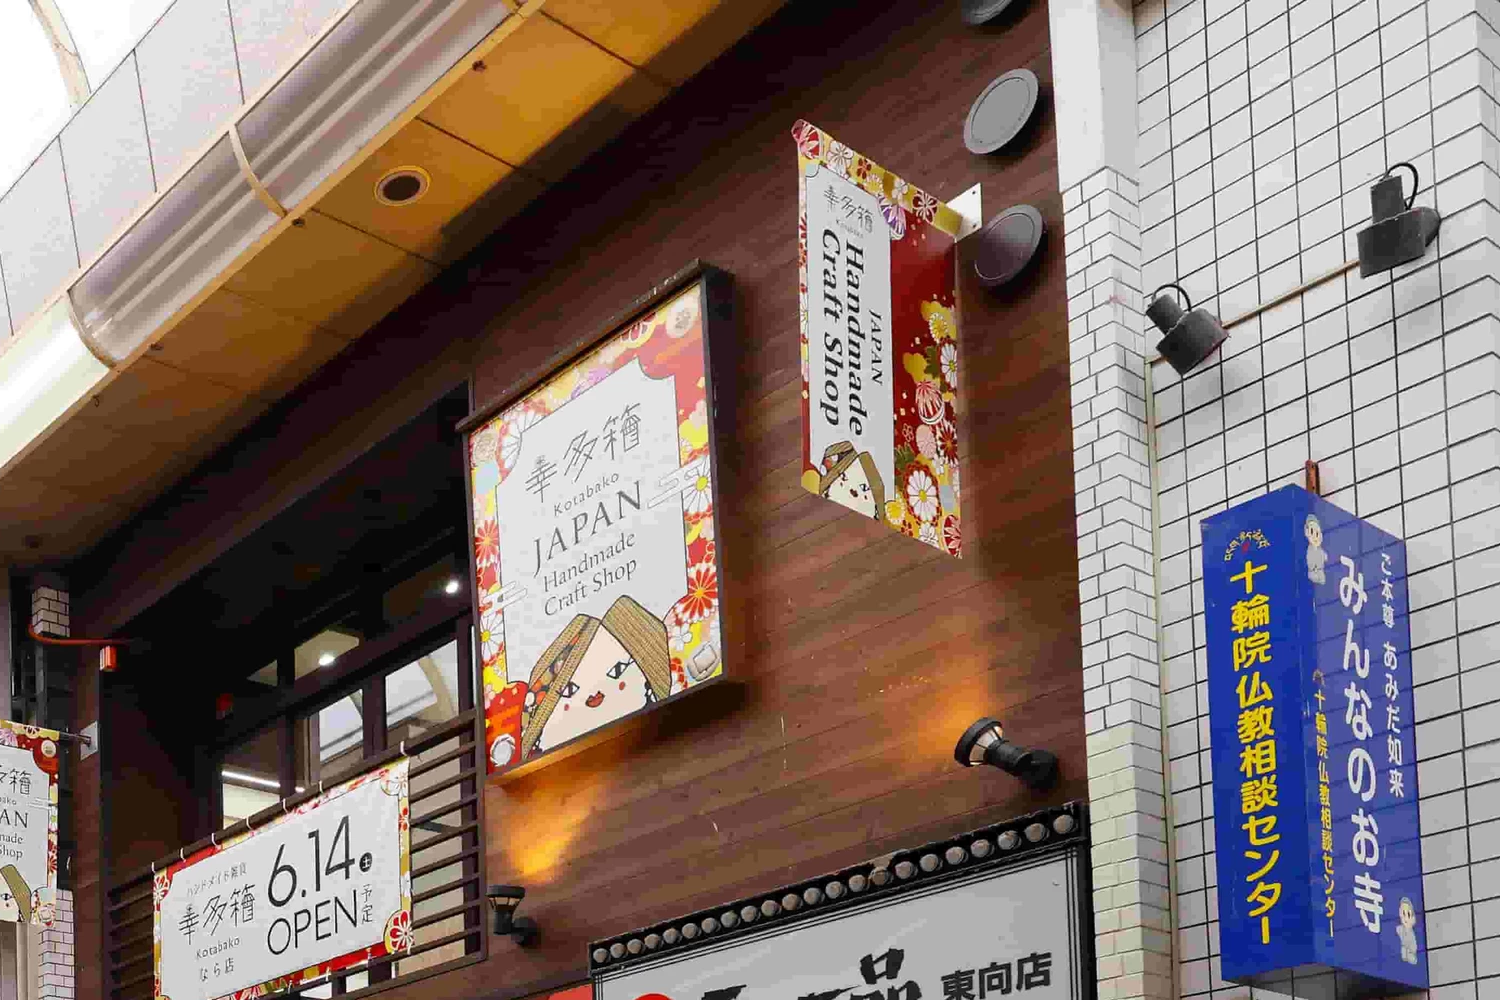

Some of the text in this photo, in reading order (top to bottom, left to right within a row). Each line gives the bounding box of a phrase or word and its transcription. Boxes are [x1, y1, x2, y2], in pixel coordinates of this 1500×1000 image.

[819, 228, 844, 426] Craft Shop
[845, 239, 869, 436] Handmade
[868, 308, 883, 386] JAPAN
[532, 480, 642, 576] JAPAN
[553, 470, 620, 517] Kotabako
[543, 530, 636, 592] Handmade
[543, 556, 638, 617] Craft Shop
[1230, 561, 1282, 944] 十輪院仏教相談センター
[1339, 554, 1385, 935] みんなのお寺
[1383, 640, 1405, 799] あみだ如来
[267, 815, 355, 907] 6.14
[267, 889, 358, 955] OPEN
[361, 884, 373, 925] 予定
[200, 957, 234, 982] なら店
